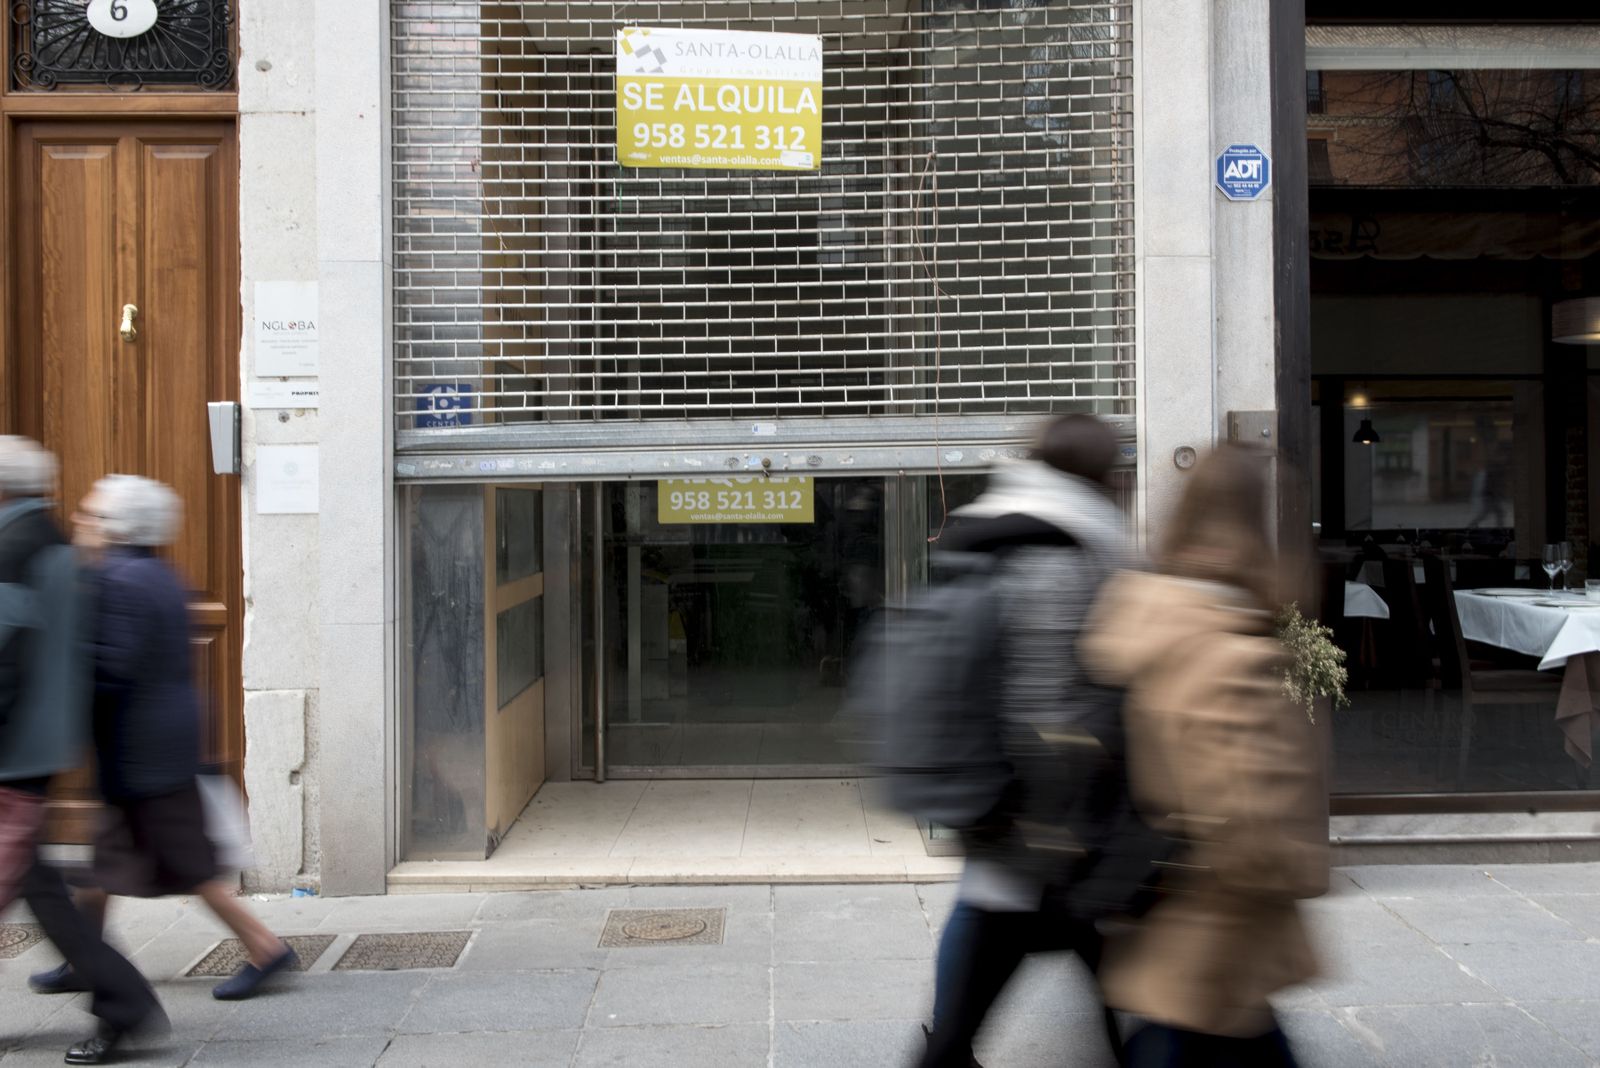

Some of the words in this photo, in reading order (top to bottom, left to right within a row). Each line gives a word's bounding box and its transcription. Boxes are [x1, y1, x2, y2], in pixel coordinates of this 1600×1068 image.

[110, 0, 127, 21] 6
[675, 41, 819, 61] SANTA-OLALLA
[623, 82, 664, 111] SE
[673, 83, 817, 115] ALQUILA
[633, 122, 686, 148] 958
[694, 124, 745, 149] 521
[755, 125, 806, 150] 312
[659, 153, 783, 166] ventas@santa-olalla.com
[1225, 160, 1261, 179] ADT
[670, 491, 710, 510] 958
[717, 491, 756, 510] 521
[762, 490, 802, 510] 312
[690, 512, 784, 521] ventas@santa-olalla.com
